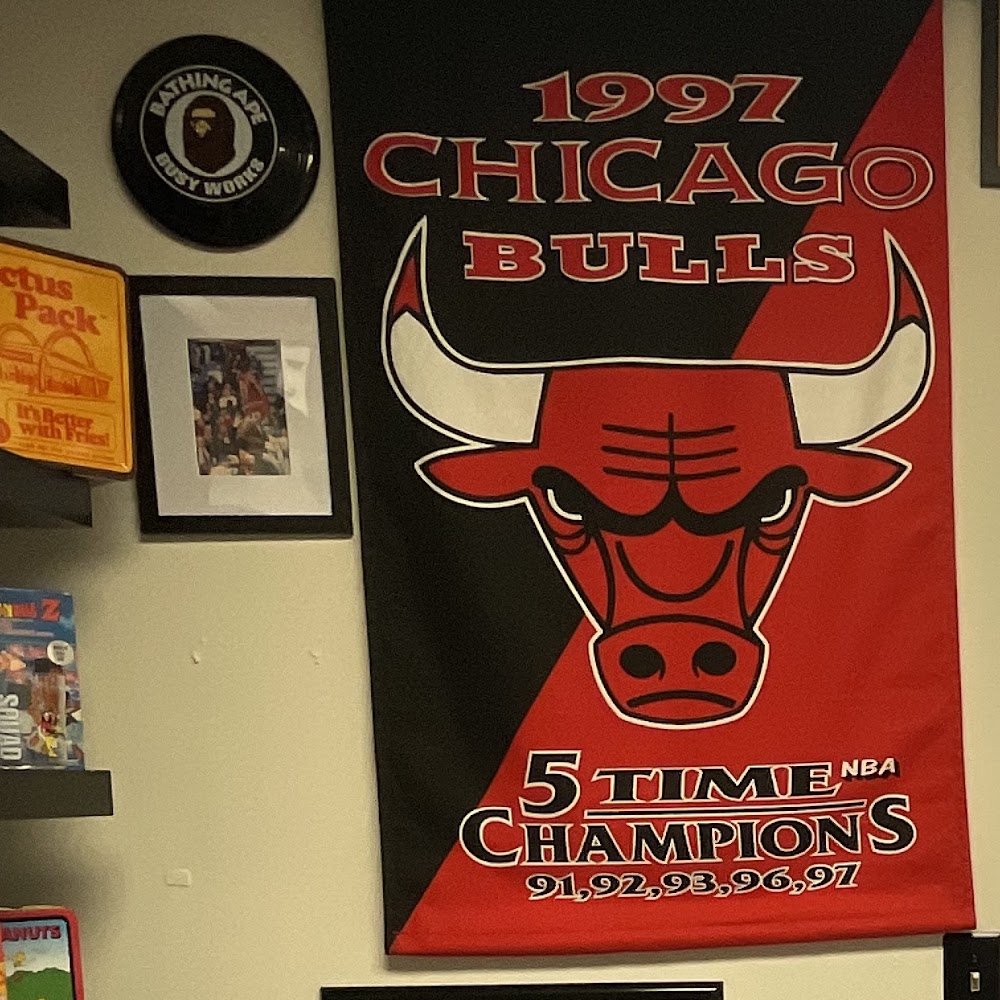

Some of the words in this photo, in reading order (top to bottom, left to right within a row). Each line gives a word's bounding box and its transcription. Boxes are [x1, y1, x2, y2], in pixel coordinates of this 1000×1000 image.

[150, 72, 232, 118] BATHING
[231, 89, 268, 126] APE
[521, 70, 803, 124] 1997
[155, 152, 200, 192] BUSY
[203, 157, 265, 197] WORKS
[363, 131, 934, 211] CHICAGO
[461, 229, 855, 285] BULLS
[15, 290, 101, 336] Pack
[518, 749, 582, 818] 5
[591, 760, 843, 804] TIME
[841, 757, 898, 780] NBA
[458, 793, 918, 868] CHAMPIONS
